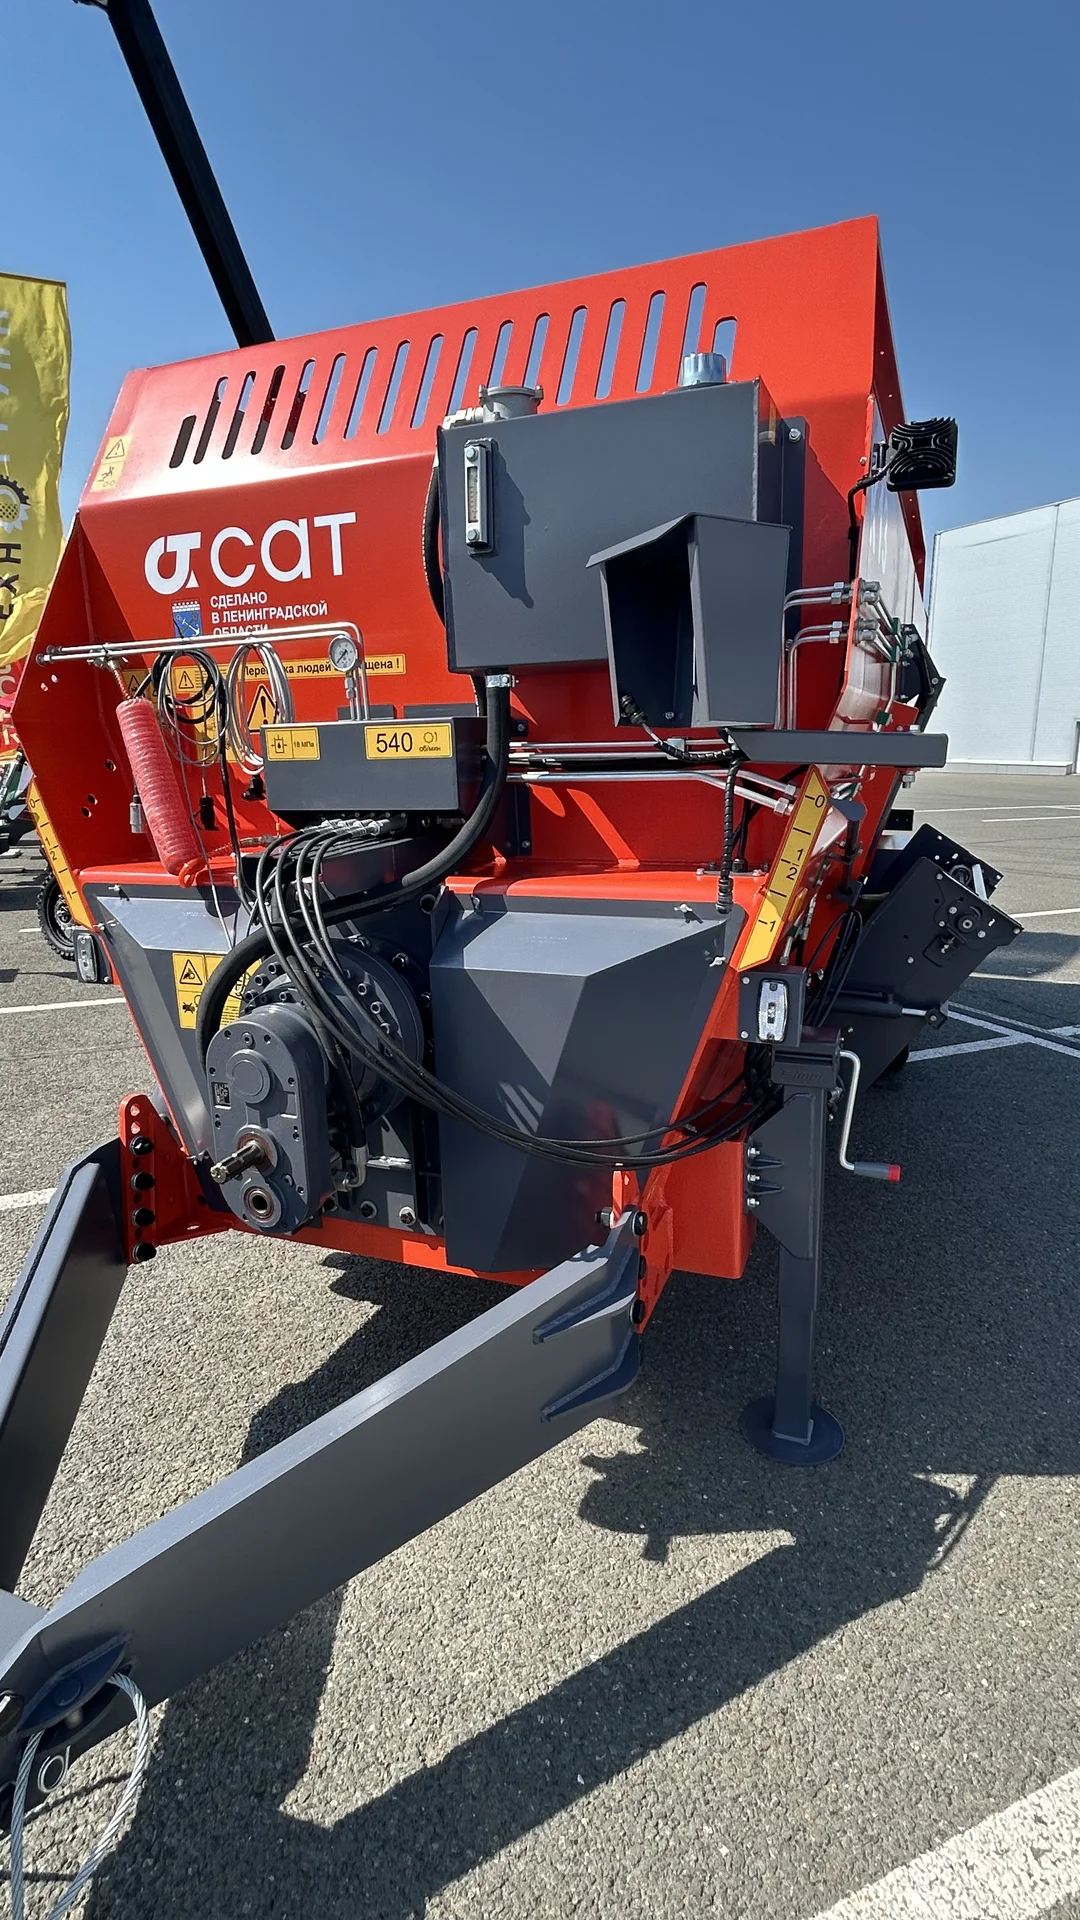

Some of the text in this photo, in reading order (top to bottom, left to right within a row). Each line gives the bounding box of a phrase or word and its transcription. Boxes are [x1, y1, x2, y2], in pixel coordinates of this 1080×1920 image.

[210, 591, 268, 609] СДЕЛАНО
[211, 600, 328, 624] В ЛЕНИНГРАДСКОЙ
[297, 661, 331, 673] людей
[376, 732, 413, 753] 540
